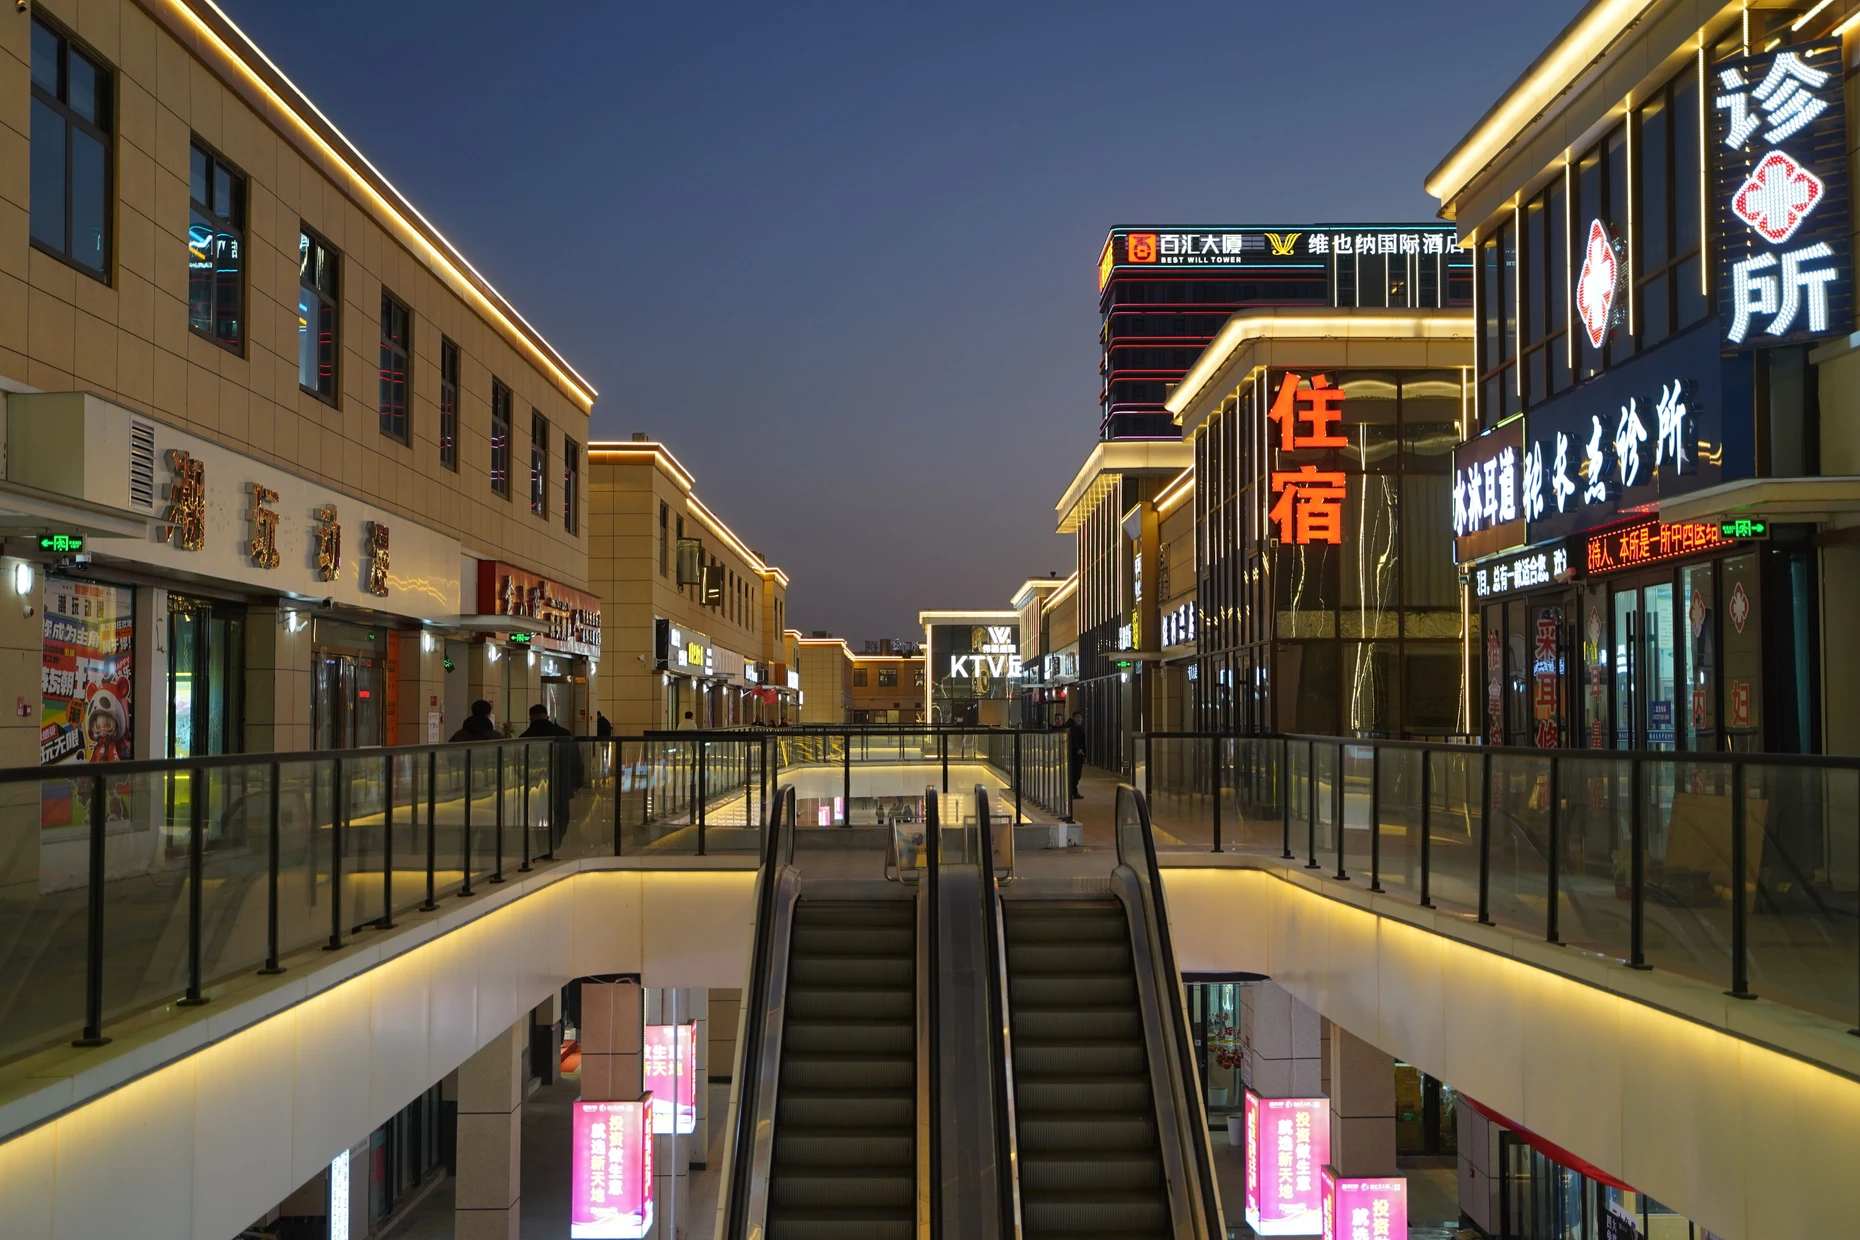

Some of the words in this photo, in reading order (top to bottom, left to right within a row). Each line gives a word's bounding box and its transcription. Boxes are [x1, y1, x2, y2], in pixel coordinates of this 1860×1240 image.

[1160, 234, 1242, 255] 百汇大厦
[1160, 256, 1184, 264] BEST
[1187, 256, 1209, 264] WILL
[1210, 256, 1242, 264] TOWER
[1308, 233, 1465, 255] 维也纳国际酒店
[1267, 371, 1348, 545] 住宿
[1453, 445, 1516, 537] 水沐耳道
[1295, 1111, 1311, 1192] 投资做生意
